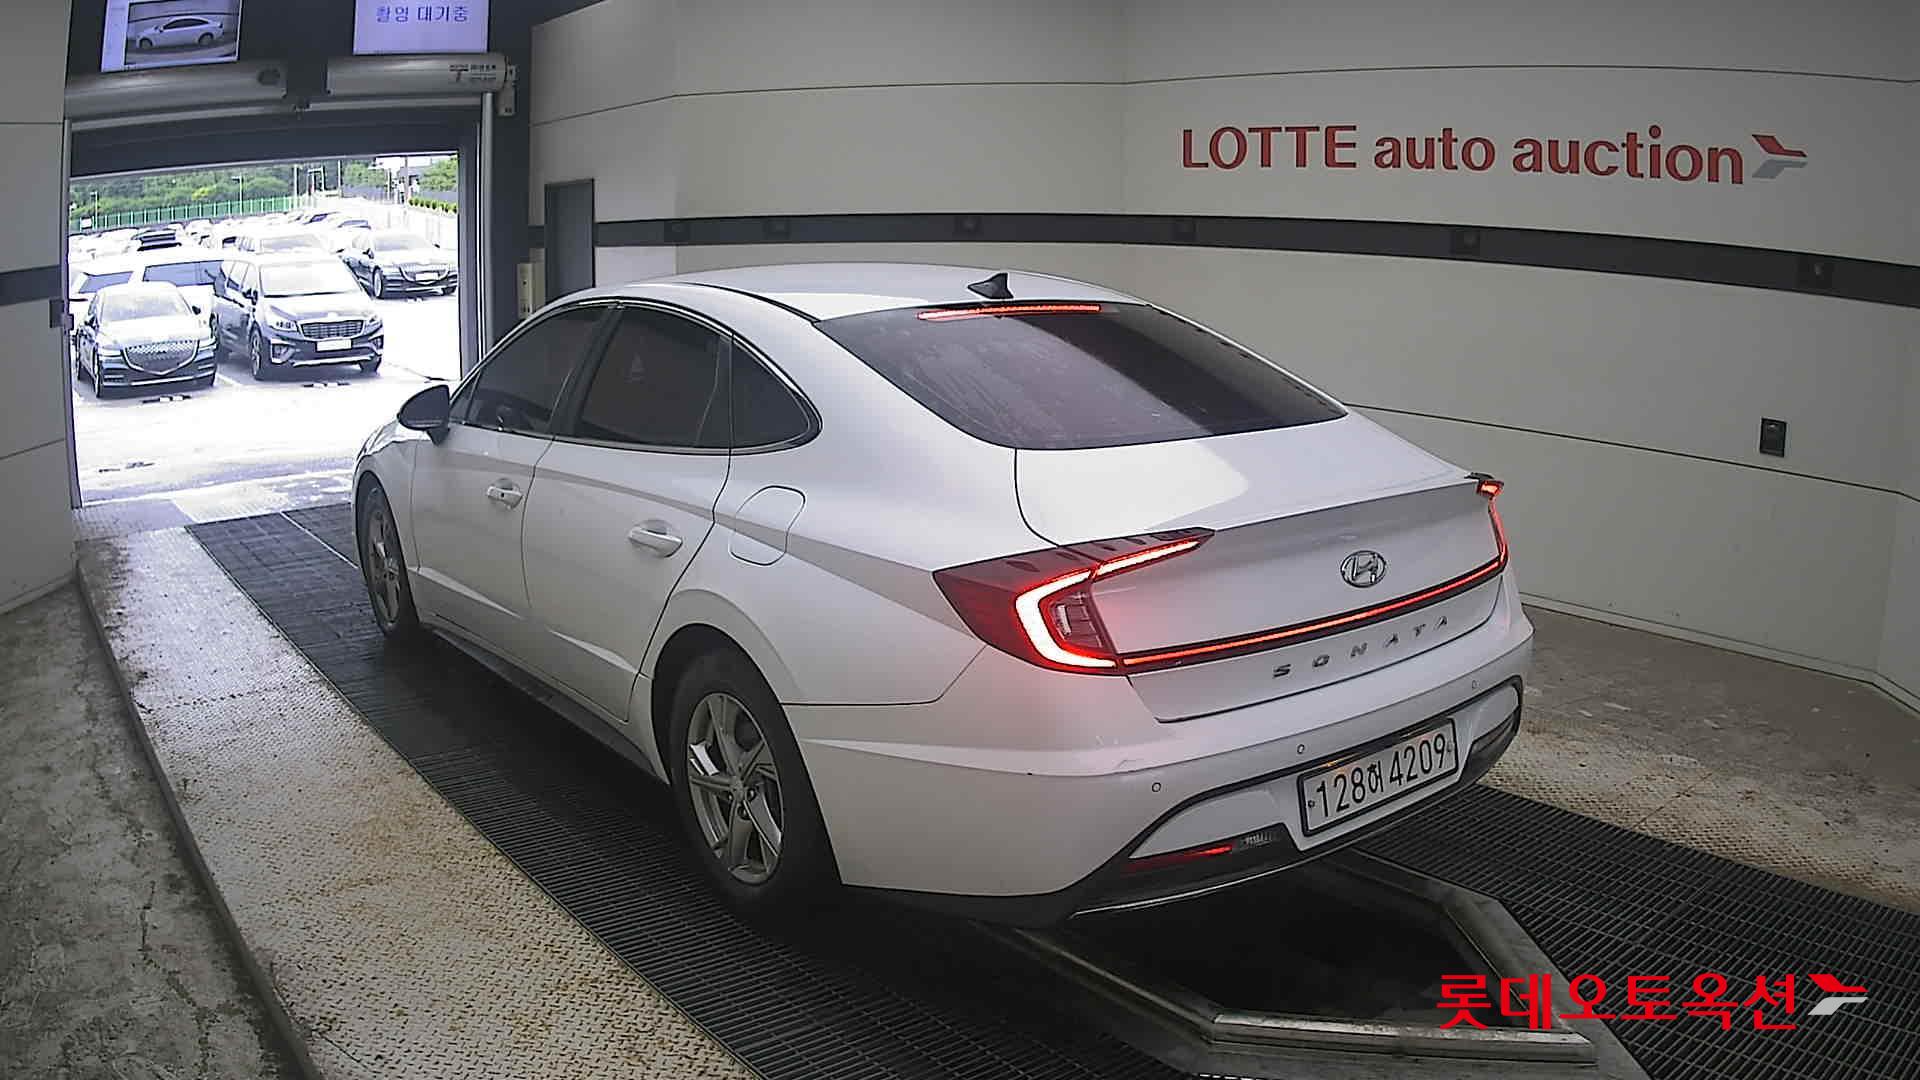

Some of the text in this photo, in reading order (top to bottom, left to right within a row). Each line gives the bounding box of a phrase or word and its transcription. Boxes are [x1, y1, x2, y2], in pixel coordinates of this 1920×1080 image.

[1182, 125, 1744, 182] LOTTE auto auction
[1272, 616, 1448, 678] SONATA
[1389, 733, 1446, 786] 4209
